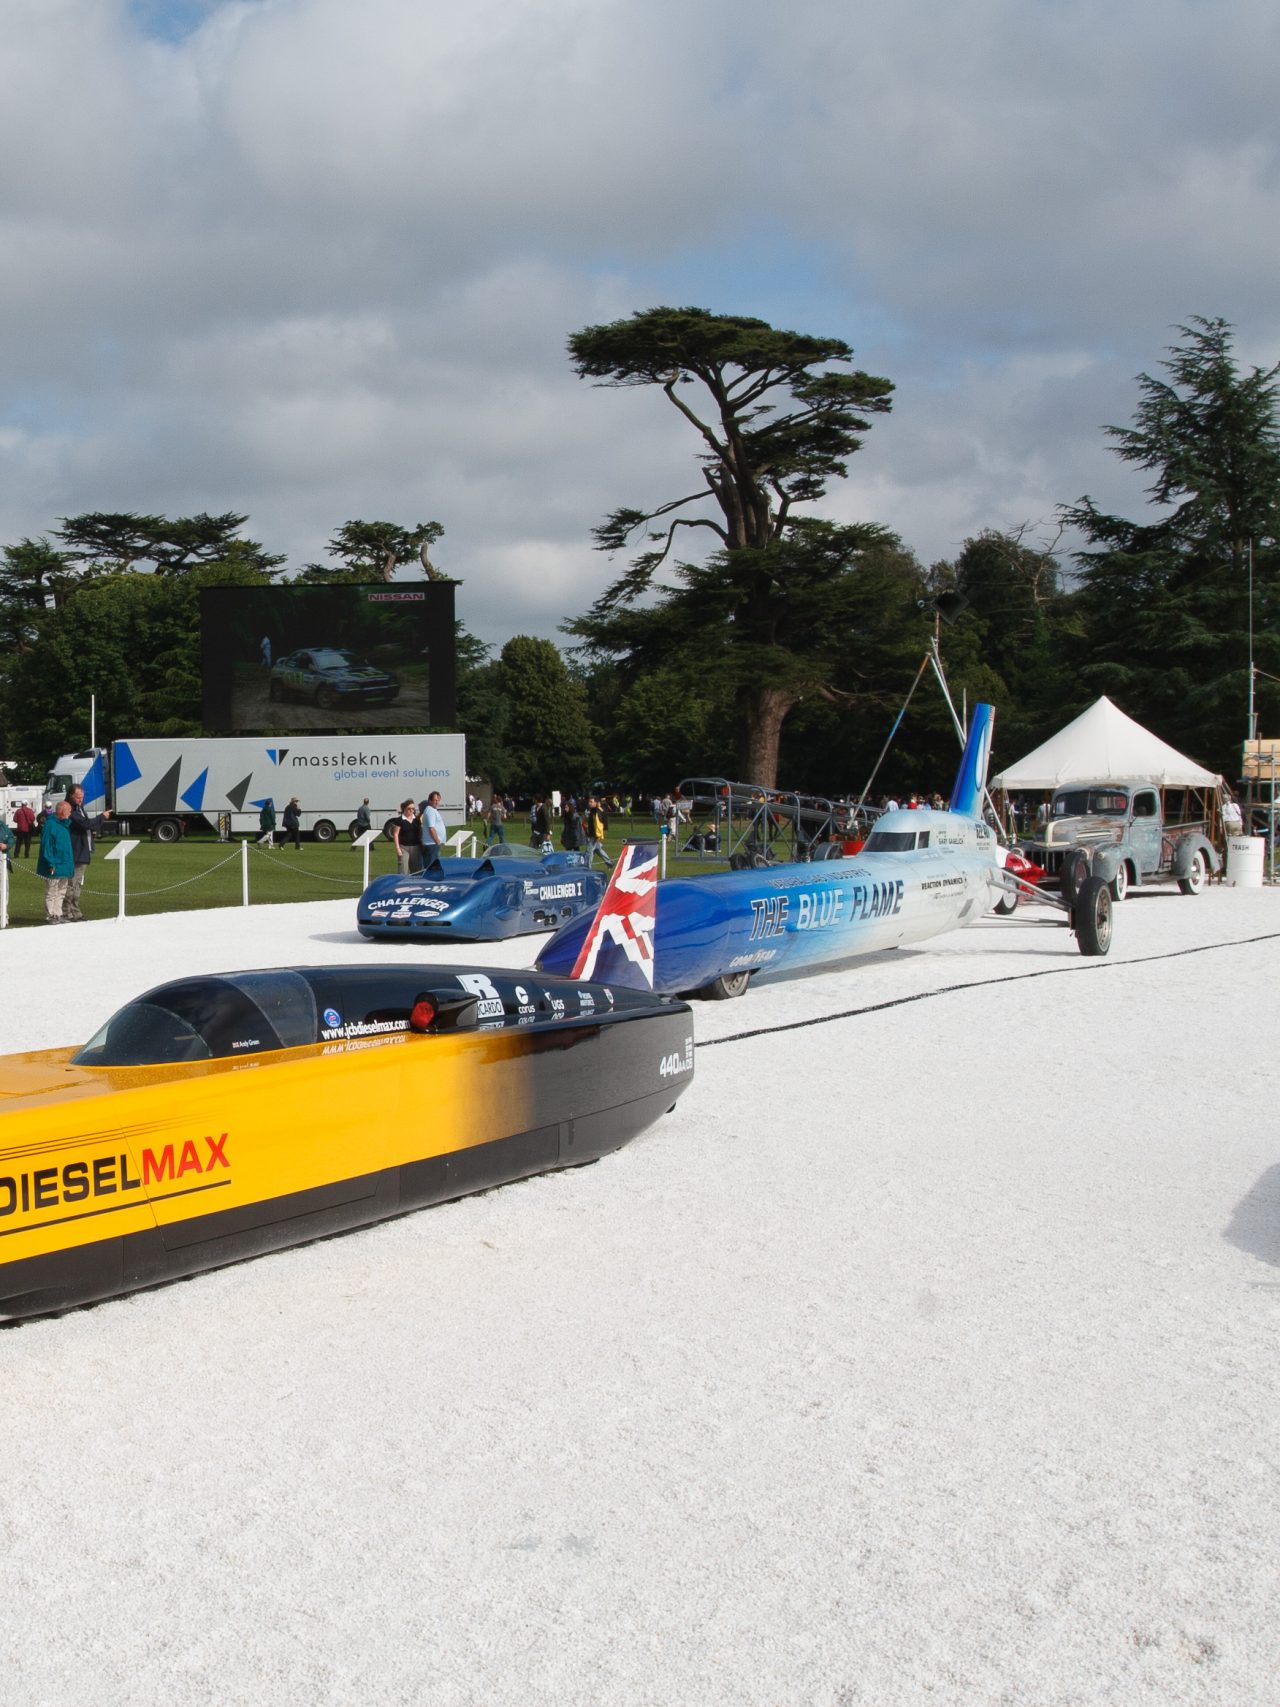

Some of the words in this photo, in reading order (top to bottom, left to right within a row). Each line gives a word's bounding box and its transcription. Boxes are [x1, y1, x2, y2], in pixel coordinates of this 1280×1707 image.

[292, 751, 398, 767] massteknik
[334, 768, 368, 781] global
[371, 768, 399, 778] event
[403, 767, 450, 778] solutions
[540, 883, 575, 900] CHALLENGER
[576, 882, 583, 896] I
[921, 881, 942, 890] REACTION
[942, 877, 964, 888] DYNAMICS
[367, 897, 450, 912] CHALLENGER
[749, 895, 790, 941] THE
[796, 887, 844, 929] BLUE
[849, 879, 905, 922] FLAME
[518, 1004, 536, 1015] corus
[551, 999, 565, 1011] UGS
[659, 1052, 679, 1078] 440
